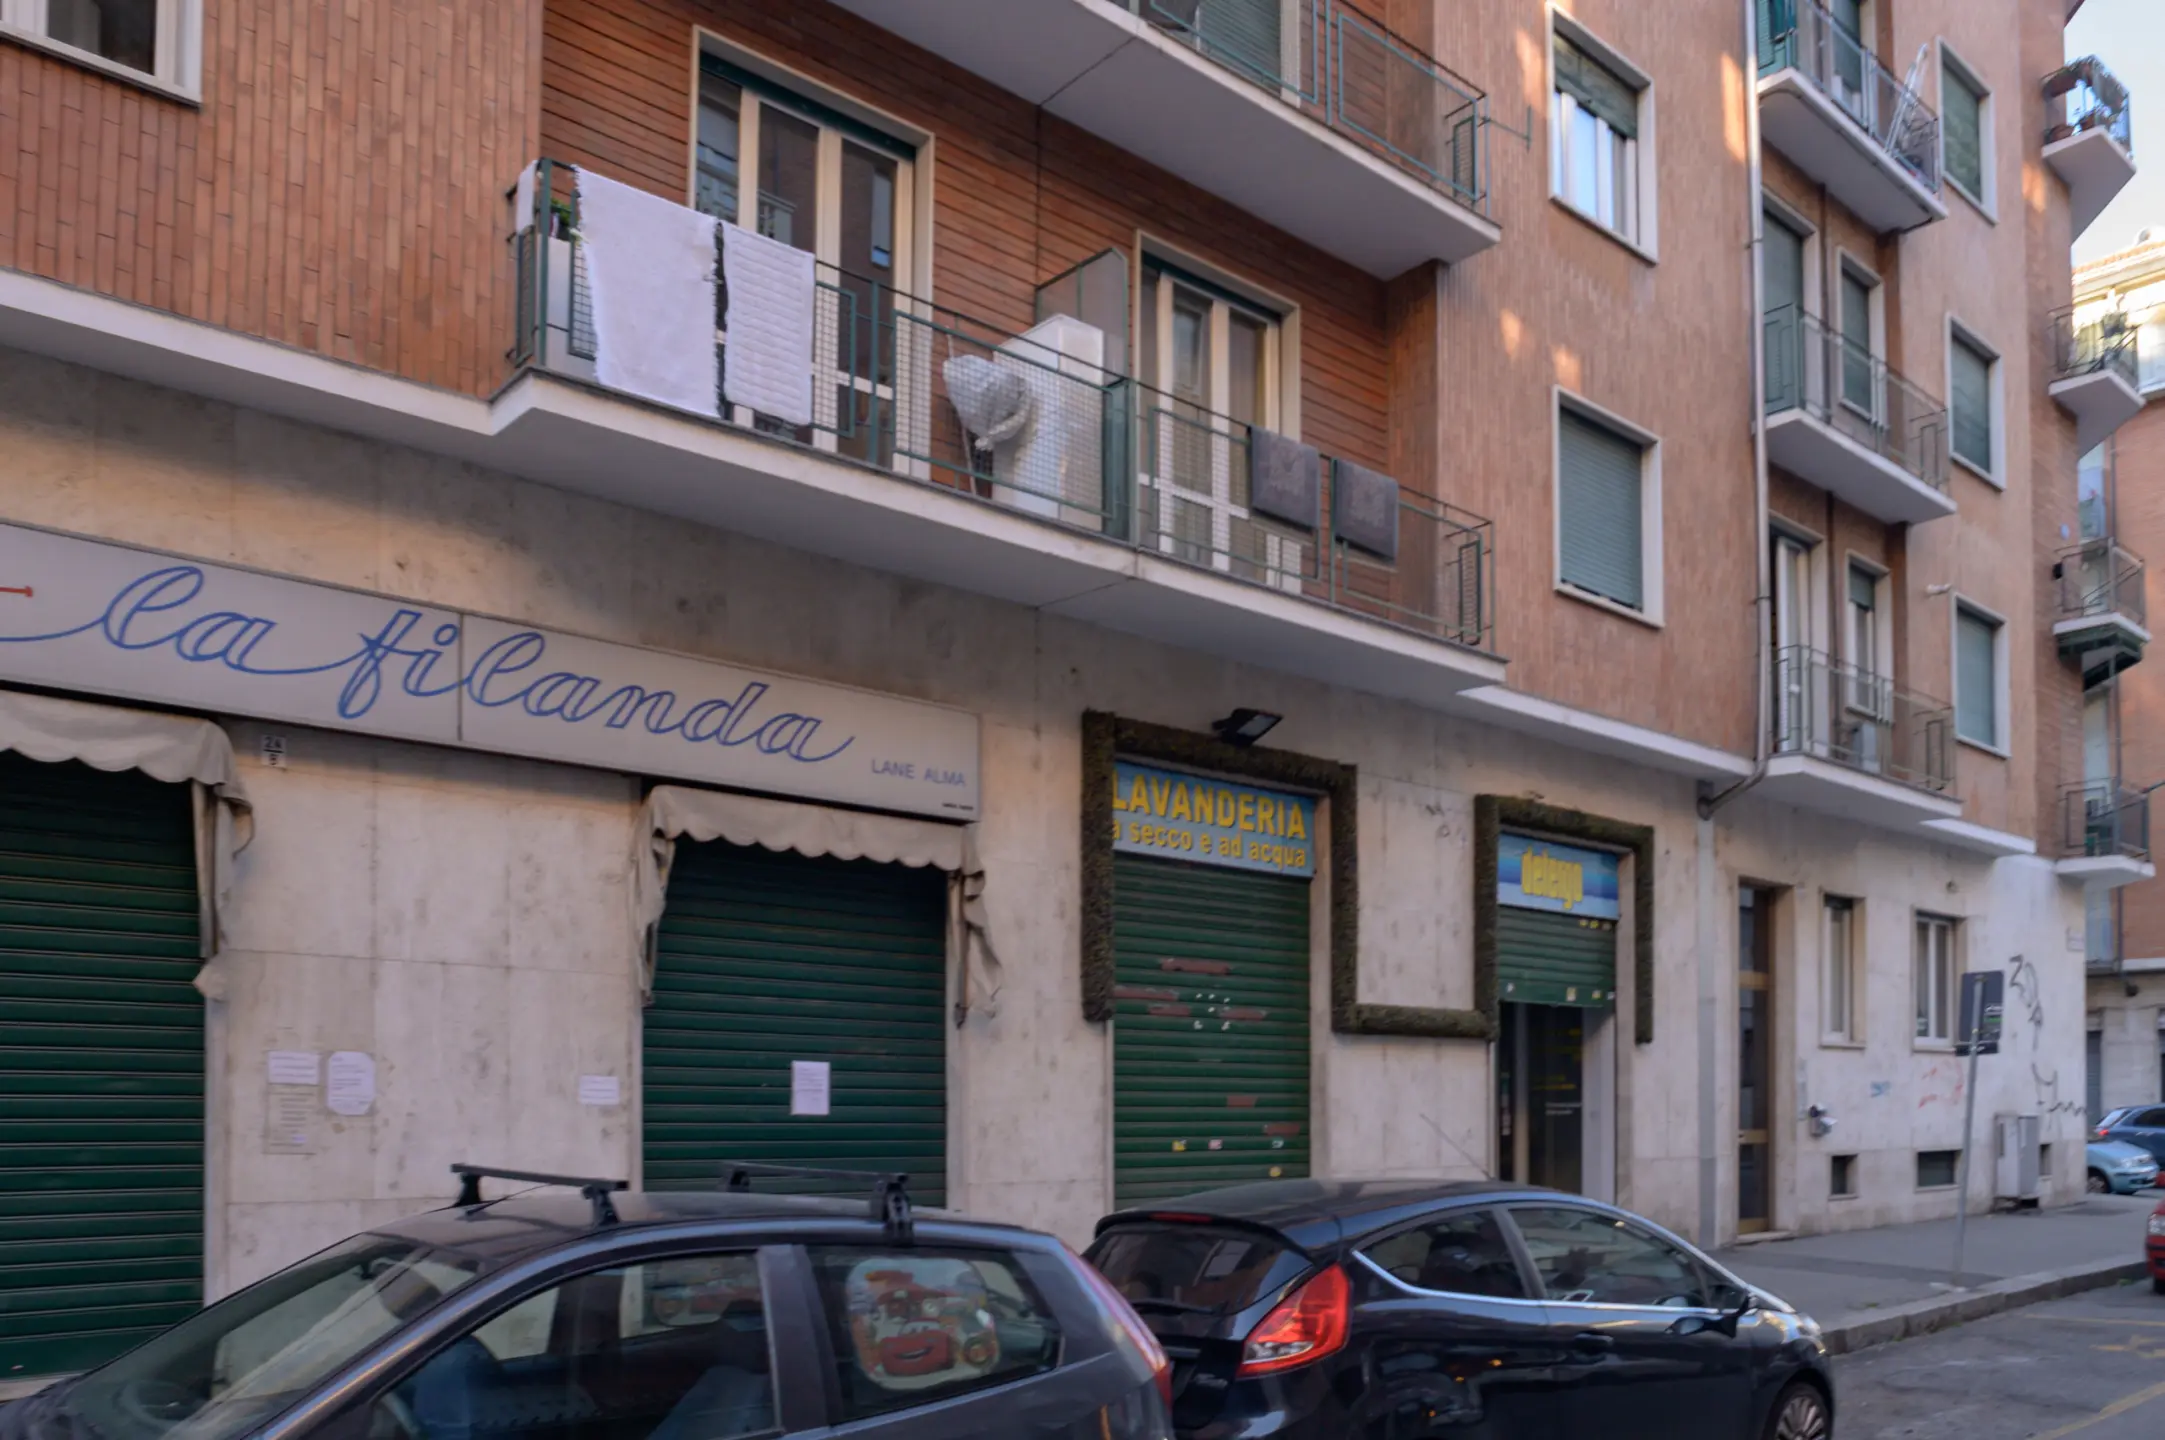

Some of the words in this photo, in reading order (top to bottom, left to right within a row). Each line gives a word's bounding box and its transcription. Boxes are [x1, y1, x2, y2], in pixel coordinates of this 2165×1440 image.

[103, 565, 278, 674] la
[337, 609, 856, 763] filanda
[871, 759, 915, 779] LANE
[924, 767, 966, 787] ALMA
[1112, 769, 1307, 841] LAVANDERIA
[1129, 820, 1193, 852] secco
[1201, 836, 1213, 855] e
[1219, 832, 1243, 858] ad
[1249, 840, 1306, 871] acqua
